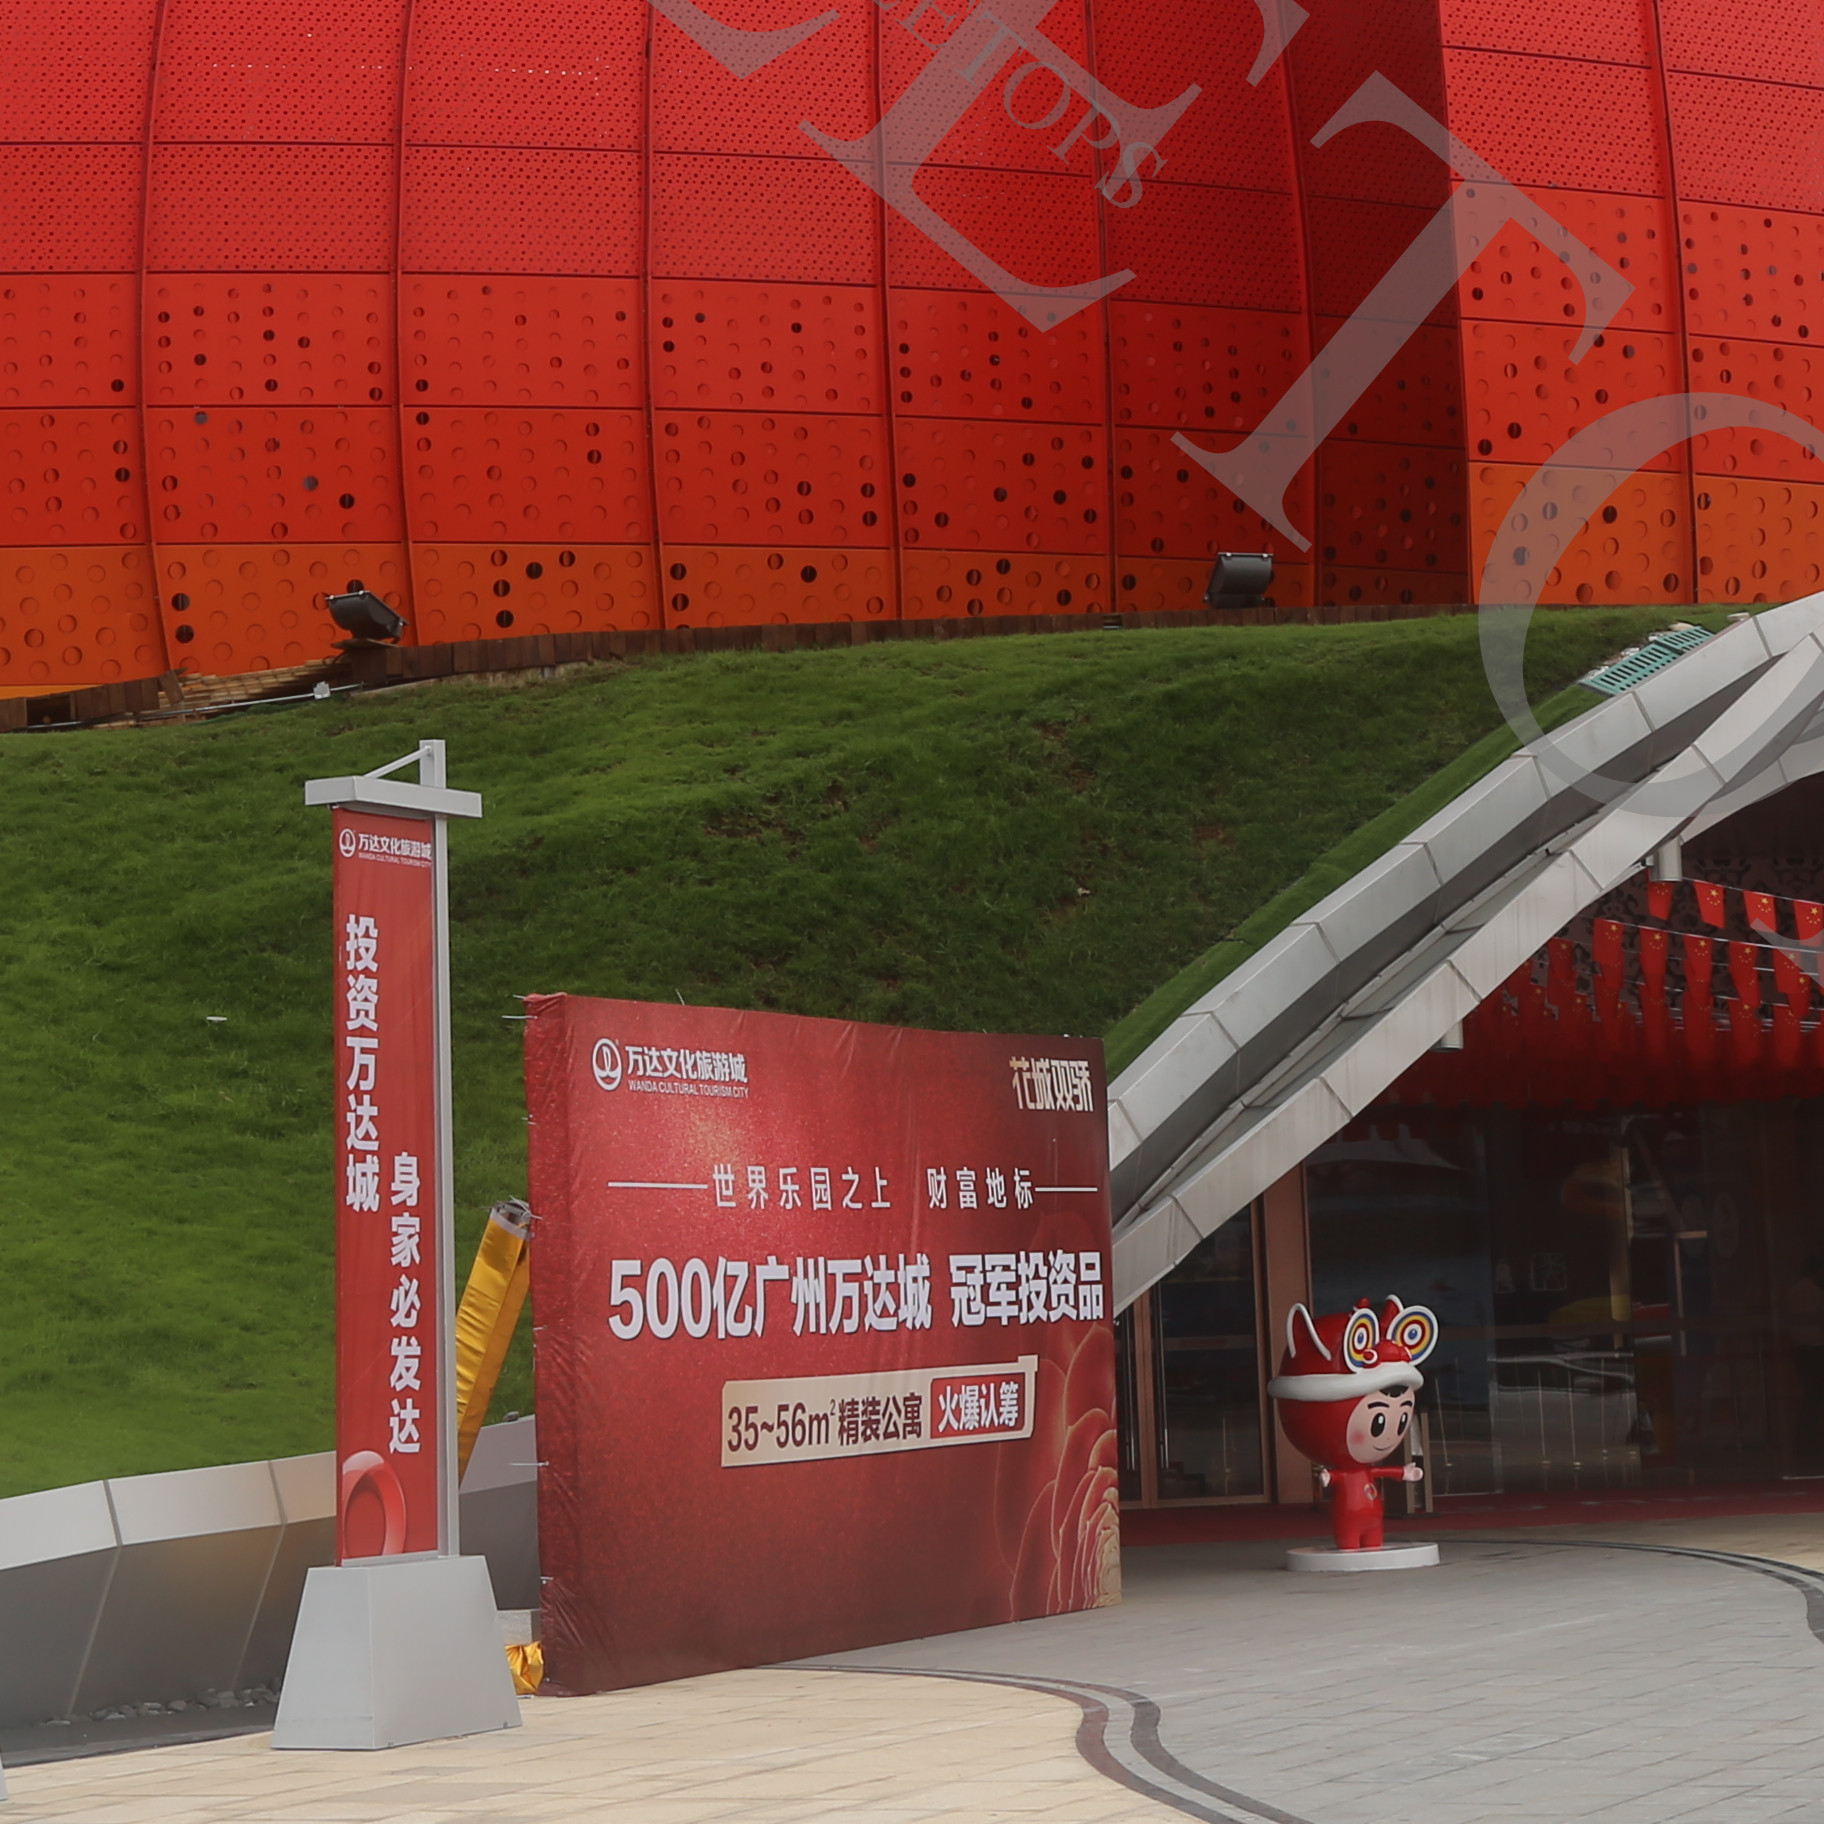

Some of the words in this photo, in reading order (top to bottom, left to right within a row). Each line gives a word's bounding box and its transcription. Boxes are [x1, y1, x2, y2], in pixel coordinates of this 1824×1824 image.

[358, 833, 432, 860] 万达文化旅游城
[345, 914, 380, 1213] 投资万达城
[625, 1045, 748, 1083] 万达文化旅游城
[628, 1079, 658, 1092] WANDA
[658, 1081, 699, 1096] CULTURAL
[699, 1083, 733, 1097] TOURISM
[733, 1086, 749, 1098] CITY
[713, 1166, 891, 1211] 世界乐园之上
[927, 1166, 1034, 1209] 财富地标
[388, 1151, 421, 1455] 身家必发达
[609, 1255, 932, 1340] 500亿广州万达城
[950, 1250, 1103, 1327] 冠军投资品
[938, 1381, 1019, 1433] 火爆认筹
